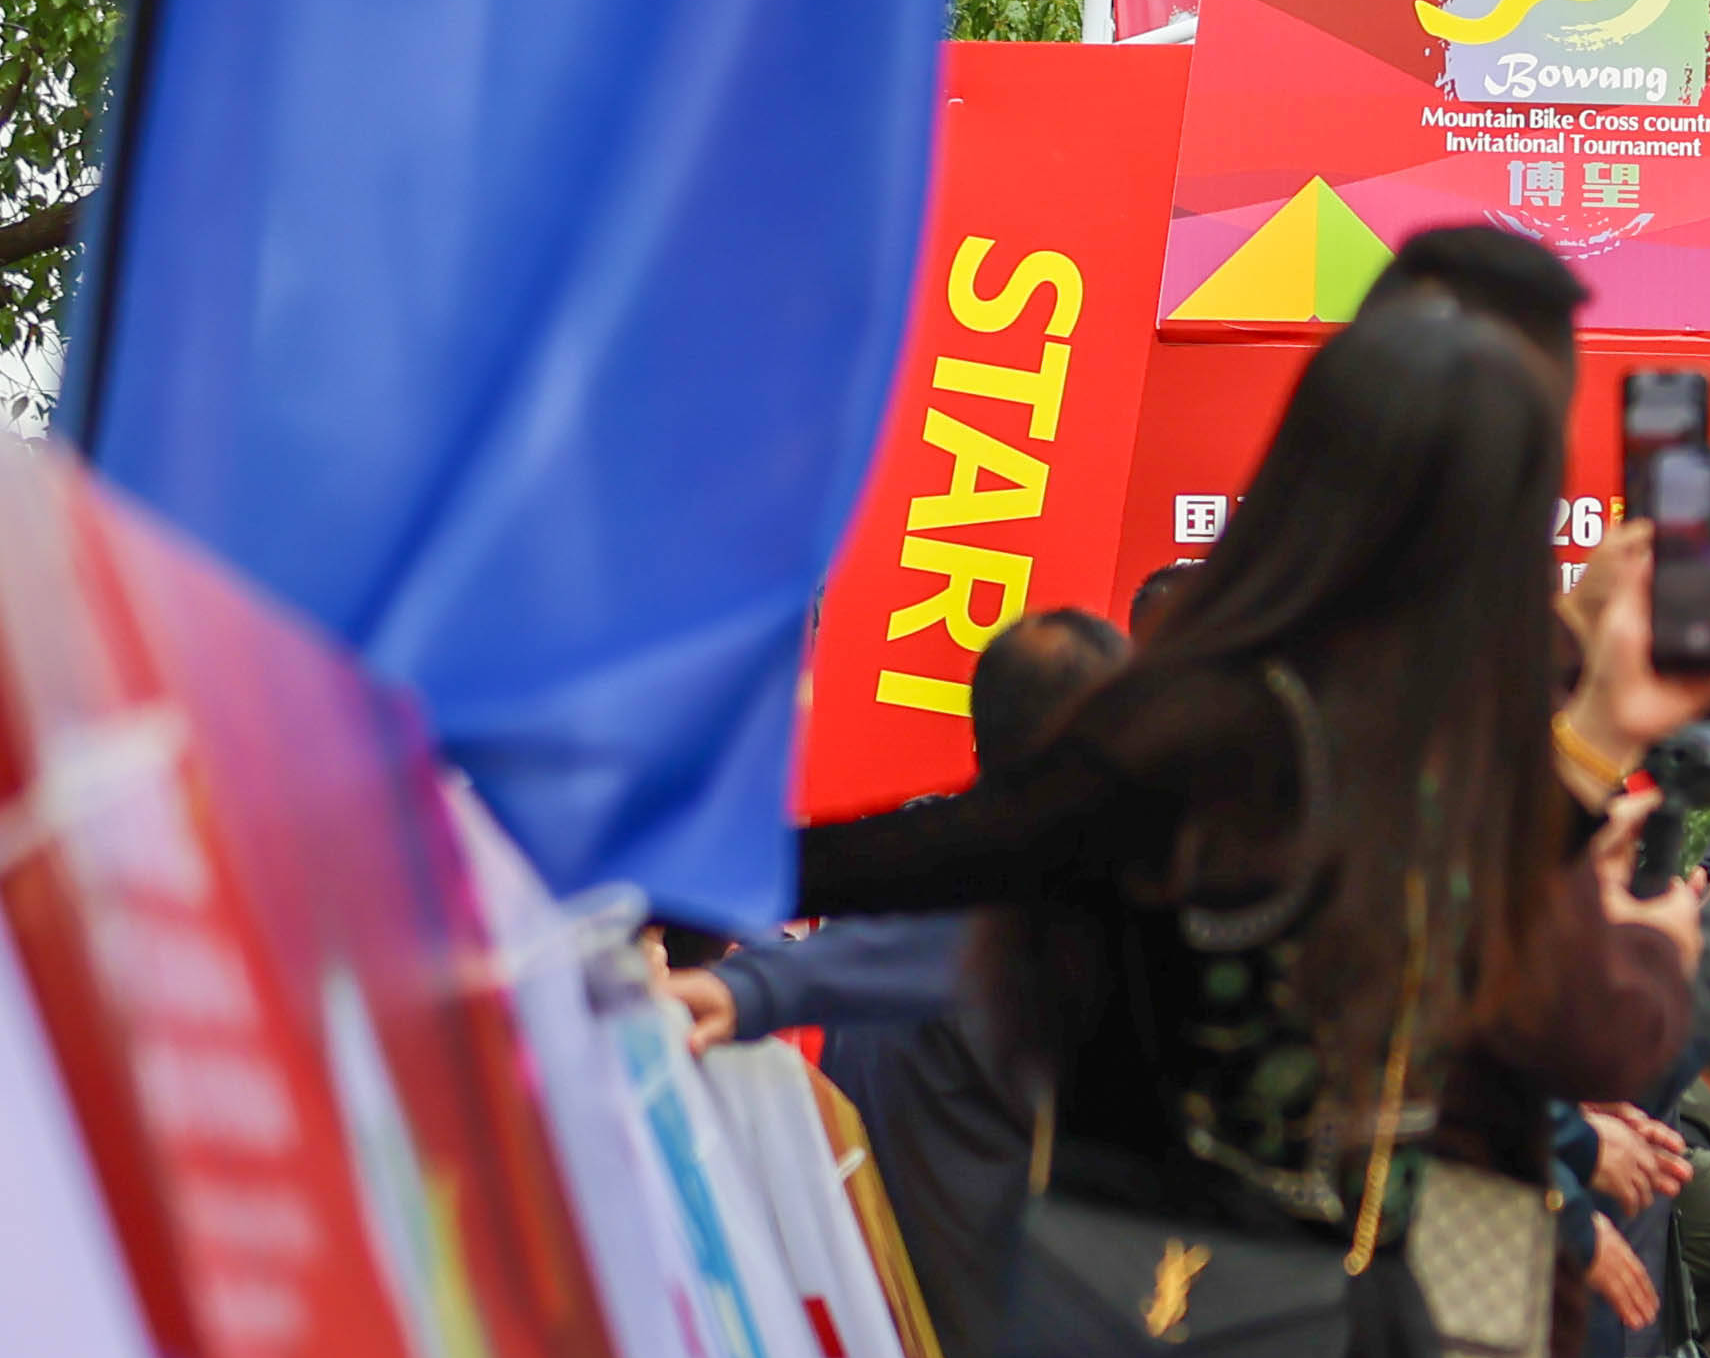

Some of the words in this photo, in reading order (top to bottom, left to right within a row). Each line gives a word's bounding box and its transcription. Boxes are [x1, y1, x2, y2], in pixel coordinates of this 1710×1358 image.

[1484, 53, 1668, 101] Bowang
[1421, 106, 1526, 130] Mountain
[1529, 108, 1575, 130] Bike
[1578, 109, 1639, 132] Cross
[1446, 131, 1565, 155] Invitational
[1569, 134, 1702, 158] Tournament
[1507, 160, 1641, 209] 博望
